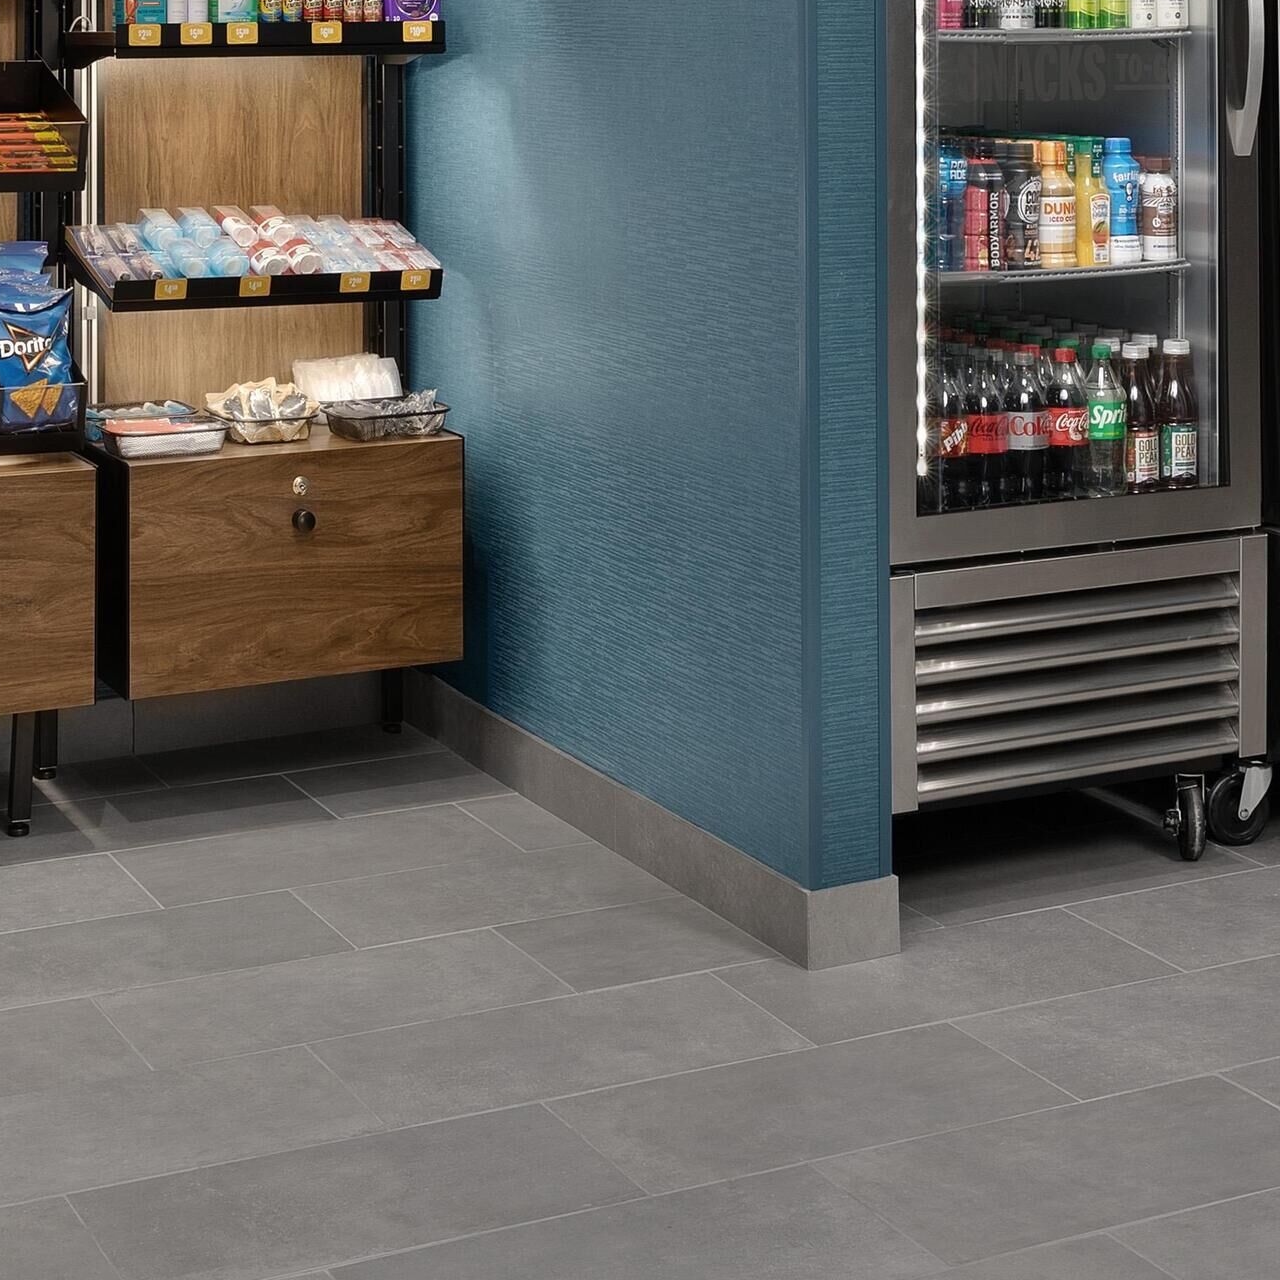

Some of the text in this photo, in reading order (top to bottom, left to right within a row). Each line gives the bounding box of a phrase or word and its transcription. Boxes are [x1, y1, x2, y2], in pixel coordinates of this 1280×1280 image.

[990, 191, 1000, 268] BODYARMOR
[1175, 434, 1196, 445] GOLD
[1175, 446, 1196, 458] PEAK
